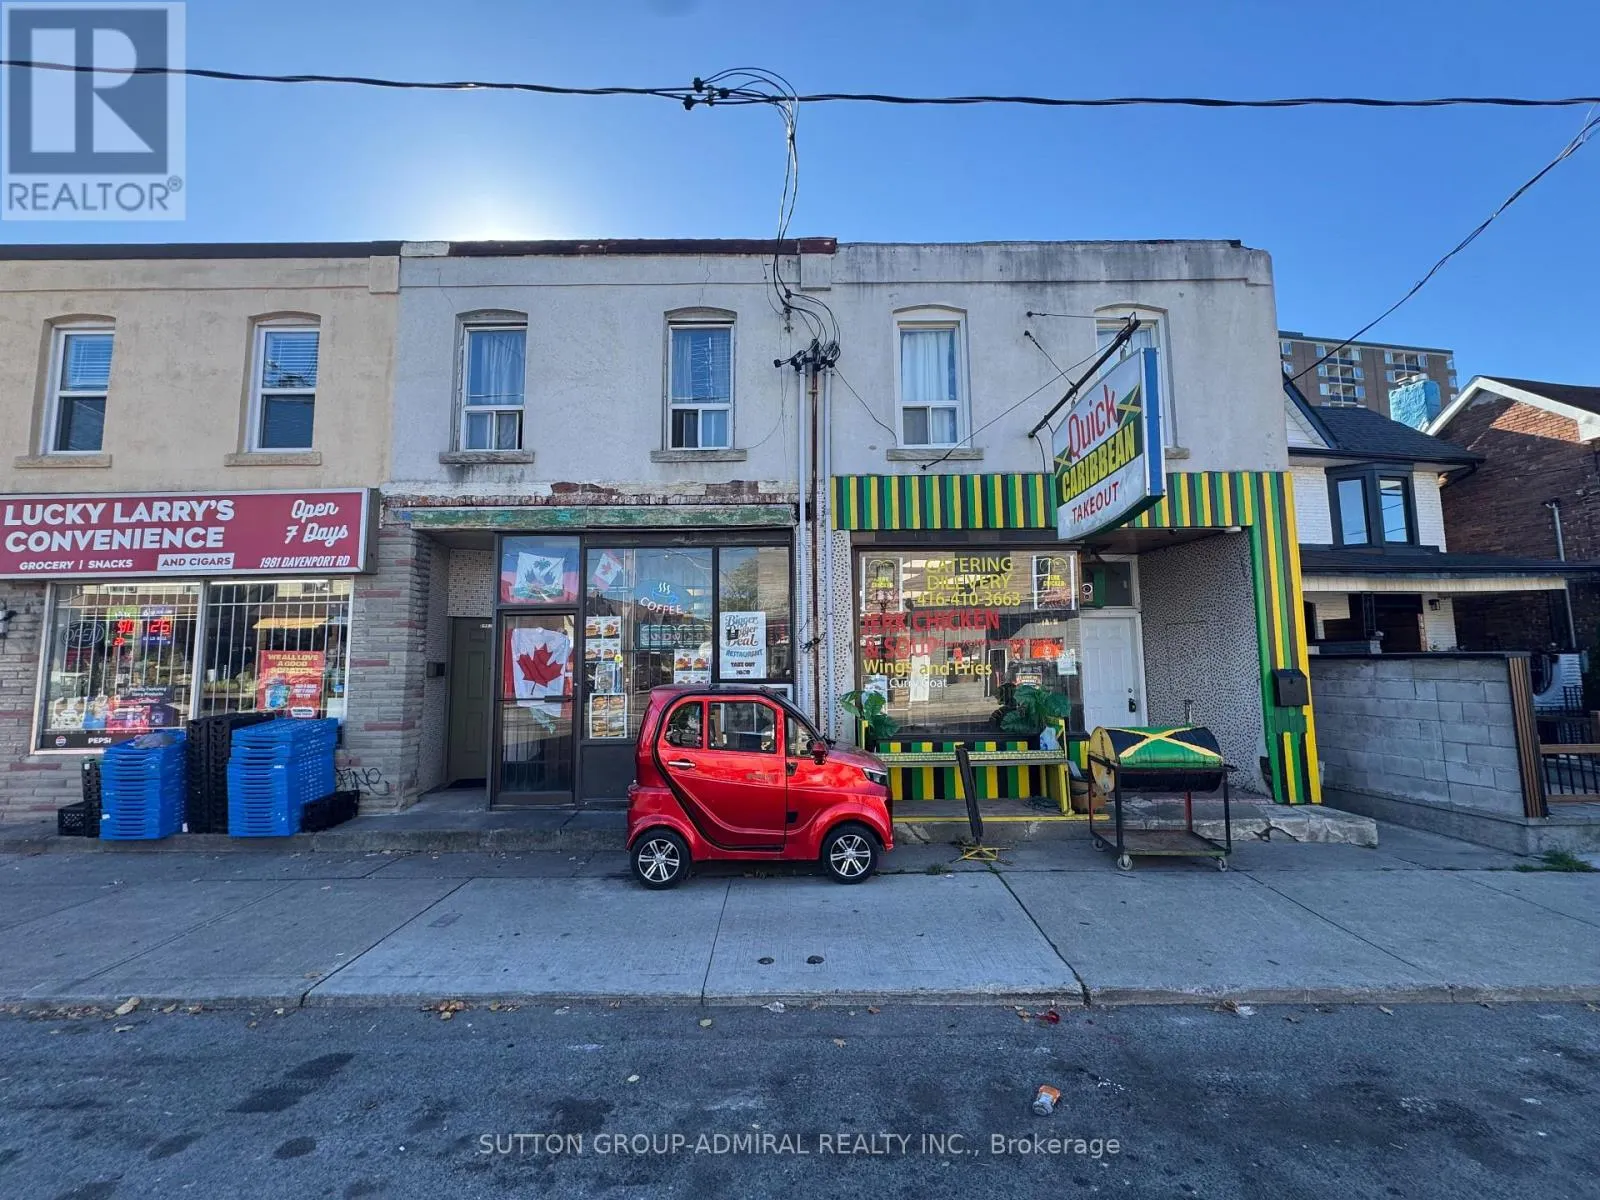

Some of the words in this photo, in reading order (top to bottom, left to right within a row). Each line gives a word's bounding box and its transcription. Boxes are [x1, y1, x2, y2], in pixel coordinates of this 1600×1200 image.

[1068, 384, 1119, 459] Quick
[1062, 420, 1135, 502] CARIBBEAN
[4, 503, 107, 526] LUCKY
[113, 499, 235, 523] LARRY'S
[291, 499, 339, 524] Open
[1071, 481, 1119, 524] TAKEOUT
[5, 527, 225, 553] CONVENIENCE
[284, 525, 299, 544] 7
[302, 522, 349, 547] Days
[19, 560, 74, 570] GROCERY
[88, 559, 133, 569] SNACKS
[162, 558, 186, 567] AND
[189, 557, 231, 566] CIGARS
[259, 557, 282, 568] 1981
[281, 555, 337, 568] DAVENPORT
[335, 555, 351, 566] RD
[925, 556, 1014, 573] CATERING
[640, 596, 683, 615] COFFEE
[916, 591, 1020, 607] 416-410-3663
[863, 612, 906, 636] JERK
[911, 608, 1000, 632] CHICKEN
[863, 659, 912, 676] Wings
[919, 662, 950, 676] and
[954, 661, 993, 675] Fries
